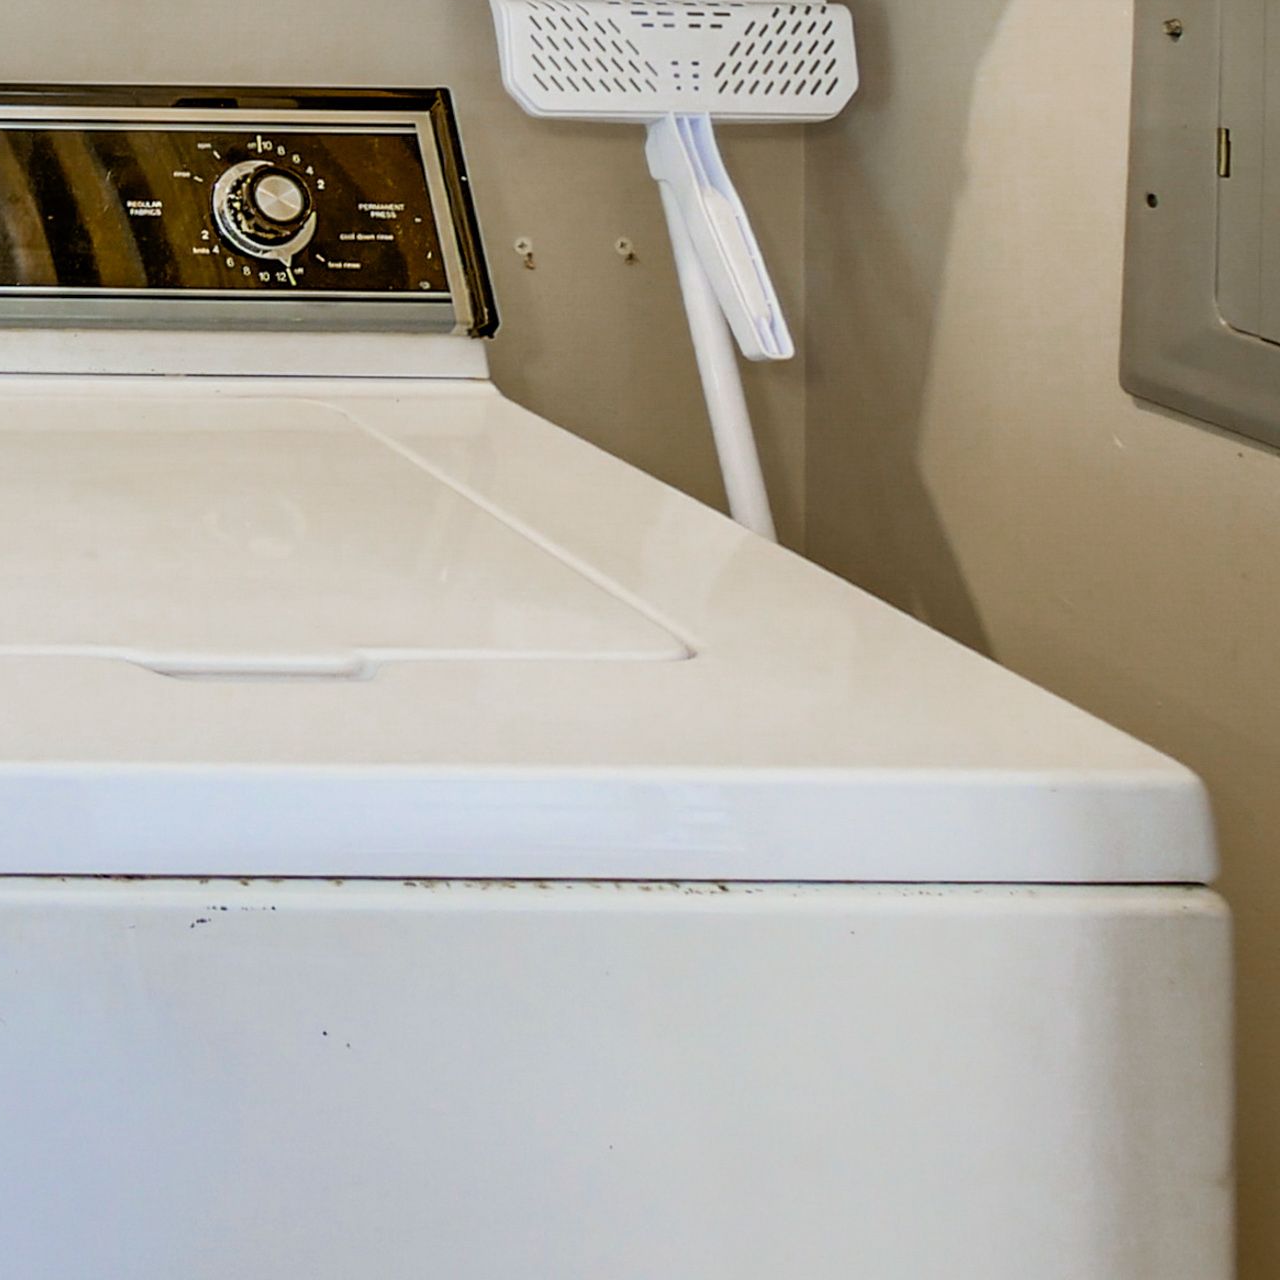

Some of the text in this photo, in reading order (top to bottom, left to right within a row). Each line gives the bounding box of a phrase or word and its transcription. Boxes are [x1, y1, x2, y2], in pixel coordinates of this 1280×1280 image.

[262, 140, 272, 150] 10
[276, 146, 286, 156] 8
[292, 154, 300, 164] 6
[306, 166, 314, 176] 4
[316, 179, 326, 190] 2
[126, 200, 162, 208] REGULAR
[358, 204, 405, 212] PERMANENT
[130, 208, 162, 216] FABRICS
[370, 211, 397, 219] PRESS
[201, 230, 209, 240] 2
[212, 244, 220, 254] 4
[226, 257, 234, 268] 6
[243, 266, 251, 276] 8
[258, 272, 270, 282] 10
[276, 272, 287, 282] 12
